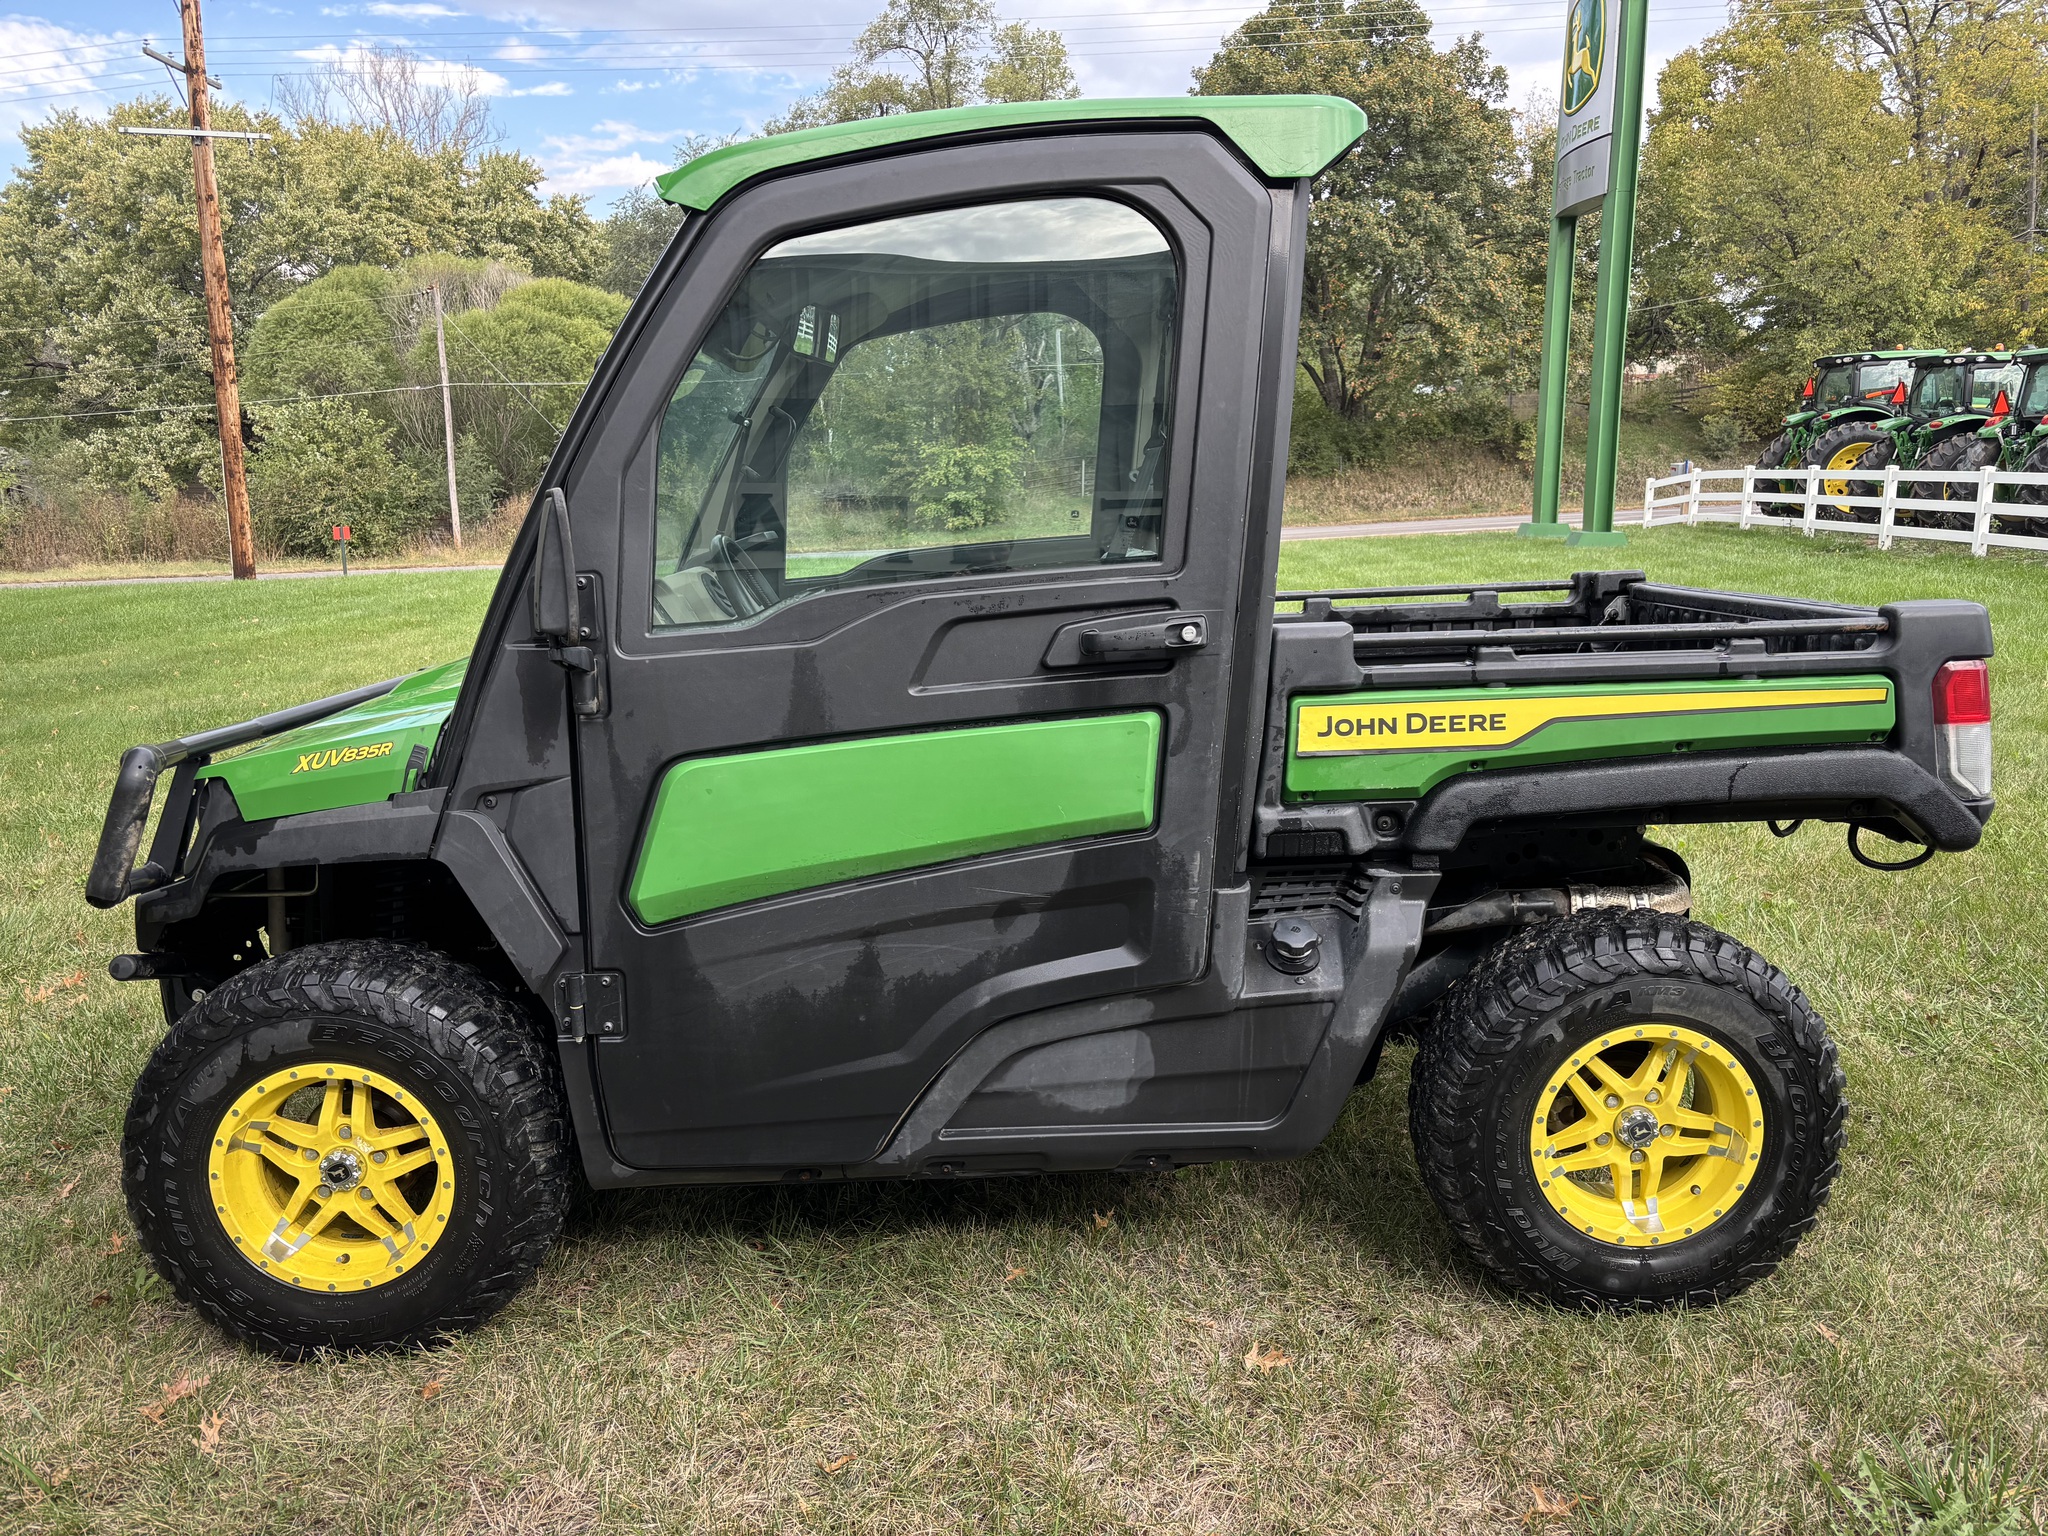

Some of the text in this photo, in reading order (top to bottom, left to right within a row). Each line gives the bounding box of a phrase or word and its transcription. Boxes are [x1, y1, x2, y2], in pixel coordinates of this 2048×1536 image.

[1572, 115, 1600, 142] DEERE
[1573, 165, 1595, 183] Tractor
[1318, 713, 1506, 737] JOHN DEERE
[290, 742, 394, 774] XUV835R
[1558, 988, 1632, 1031] T/A
[1637, 984, 1687, 998] KM3
[160, 1094, 198, 1166] T/A
[311, 1023, 495, 1237] BFGoodrich
[1711, 1031, 1805, 1269] BFGoodrich
